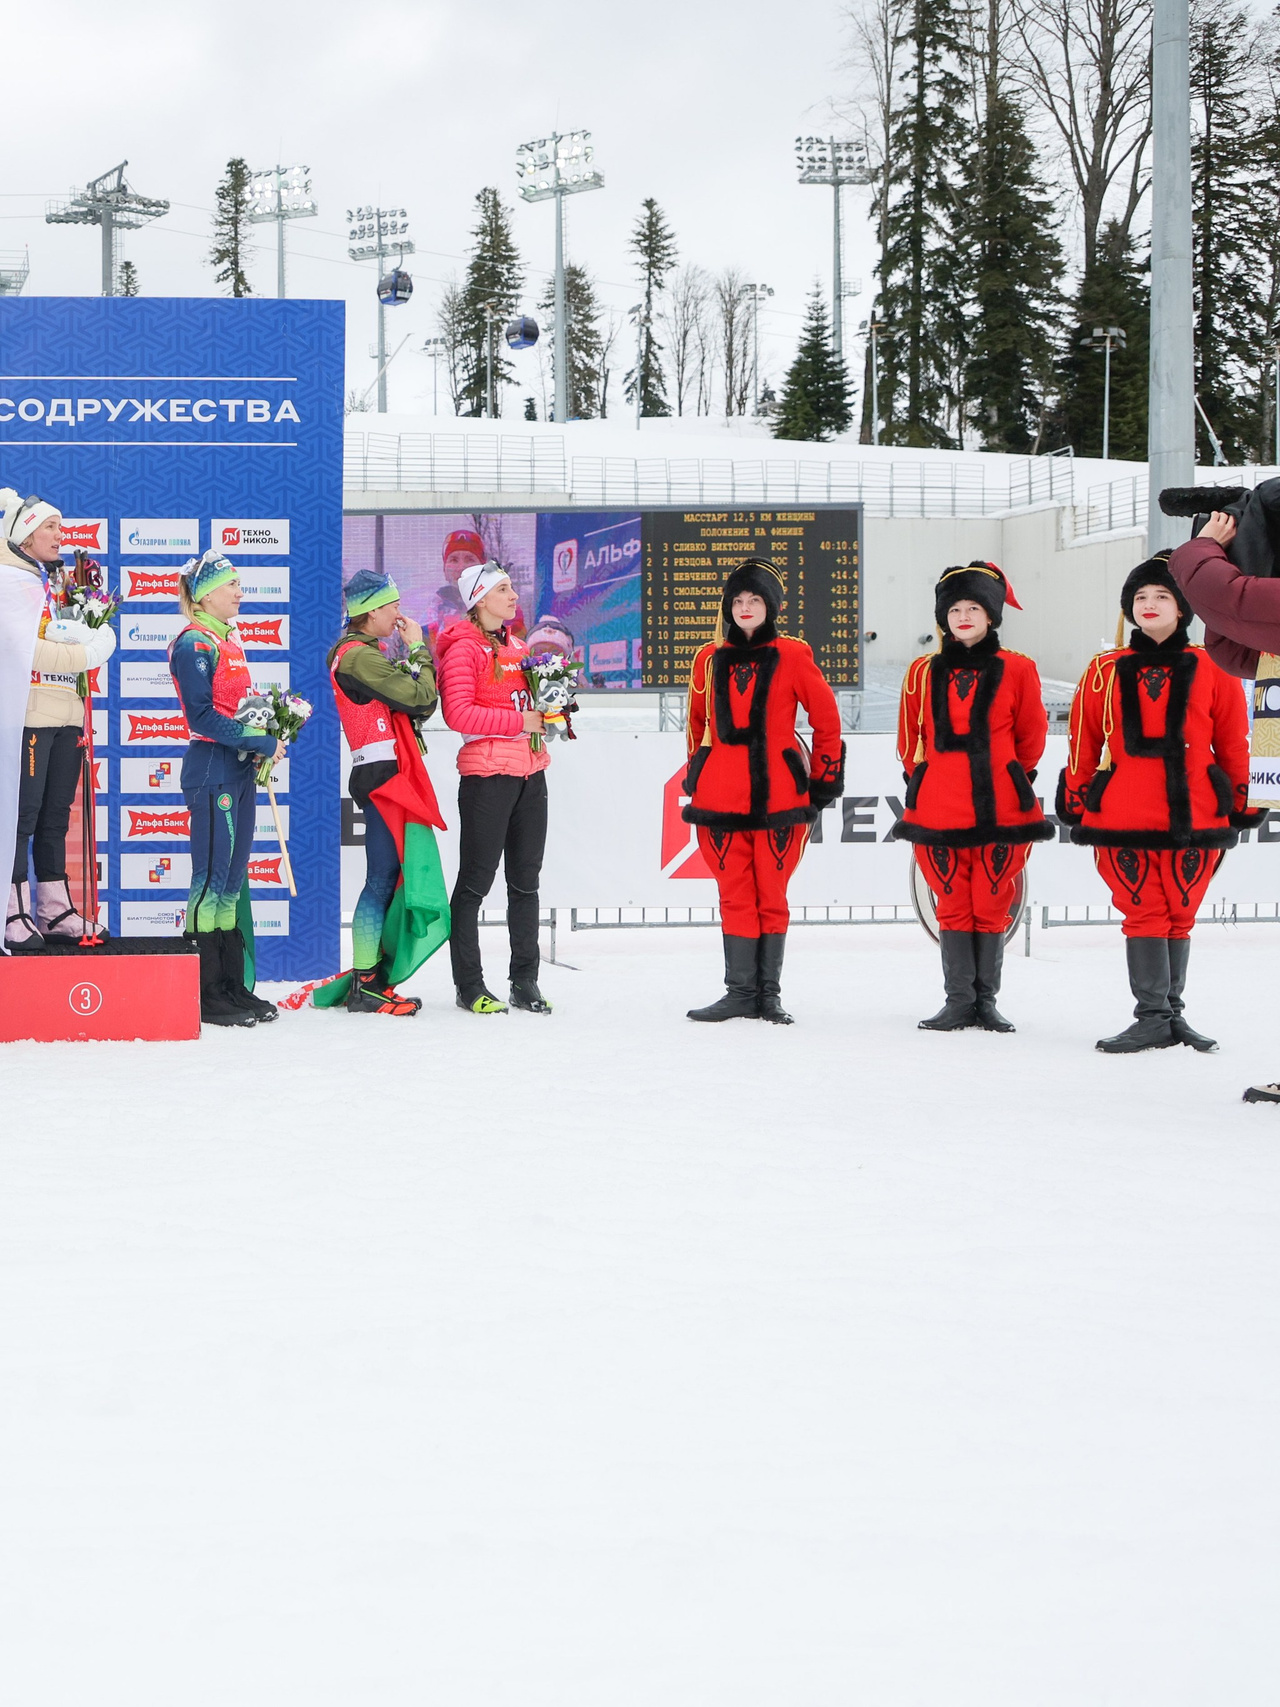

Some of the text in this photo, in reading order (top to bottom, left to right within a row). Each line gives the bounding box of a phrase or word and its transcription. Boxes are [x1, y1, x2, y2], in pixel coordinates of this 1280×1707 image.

[684, 513, 728, 523] МАССТАРТ
[733, 512, 755, 523] 12,5
[72, 532, 93, 540] Банк
[700, 528, 750, 537] ПОЛОЖЕНИЕ
[754, 527, 767, 536] НА
[646, 541, 858, 552] 1 3 СЛИВКО ВИКТОРИЯ РОС 1 40:10.6
[584, 538, 641, 570] АЛЬФ
[646, 558, 652, 566] 2
[663, 558, 669, 566] 2
[673, 558, 713, 567] РЕЗЦОВА
[798, 556, 804, 566] 3
[836, 555, 858, 565] +3.8
[646, 572, 652, 581] 3
[663, 572, 669, 581] 1
[673, 572, 718, 581] ШЕВЧЕНКО
[798, 570, 804, 580] 4
[831, 570, 858, 580] +14.4
[135, 579, 163, 590] Альфа
[646, 586, 652, 596] 4
[663, 586, 669, 596] 5
[673, 586, 723, 596] СМОЛЬСКАЯ
[798, 585, 804, 594] 2
[831, 585, 858, 595] +23.2
[646, 602, 652, 610] 5
[663, 602, 669, 610] 6
[673, 601, 696, 611] СОЛА
[798, 600, 804, 610] 2
[831, 600, 858, 609] +30.8
[646, 614, 858, 625] 6 12 КОВАЛЕНК ОС 2 +36.7
[646, 630, 652, 640] 7
[658, 630, 669, 640] 10
[831, 629, 858, 638] +44.7
[646, 646, 652, 654] 8
[658, 646, 669, 654] 13
[820, 643, 858, 653] +1:08.6
[646, 660, 652, 669] 9
[663, 660, 669, 669] 8
[820, 658, 858, 668] +1:19.3
[642, 675, 652, 684] 10
[658, 675, 669, 684] 20
[825, 673, 858, 682] 1:30.6
[135, 723, 163, 734] Альфа
[376, 718, 387, 732] 6
[135, 818, 184, 830] Альфа Банк
[254, 866, 275, 874] Банк
[259, 920, 282, 928] ПОЛЯНА
[80, 988, 91, 1009] 3
